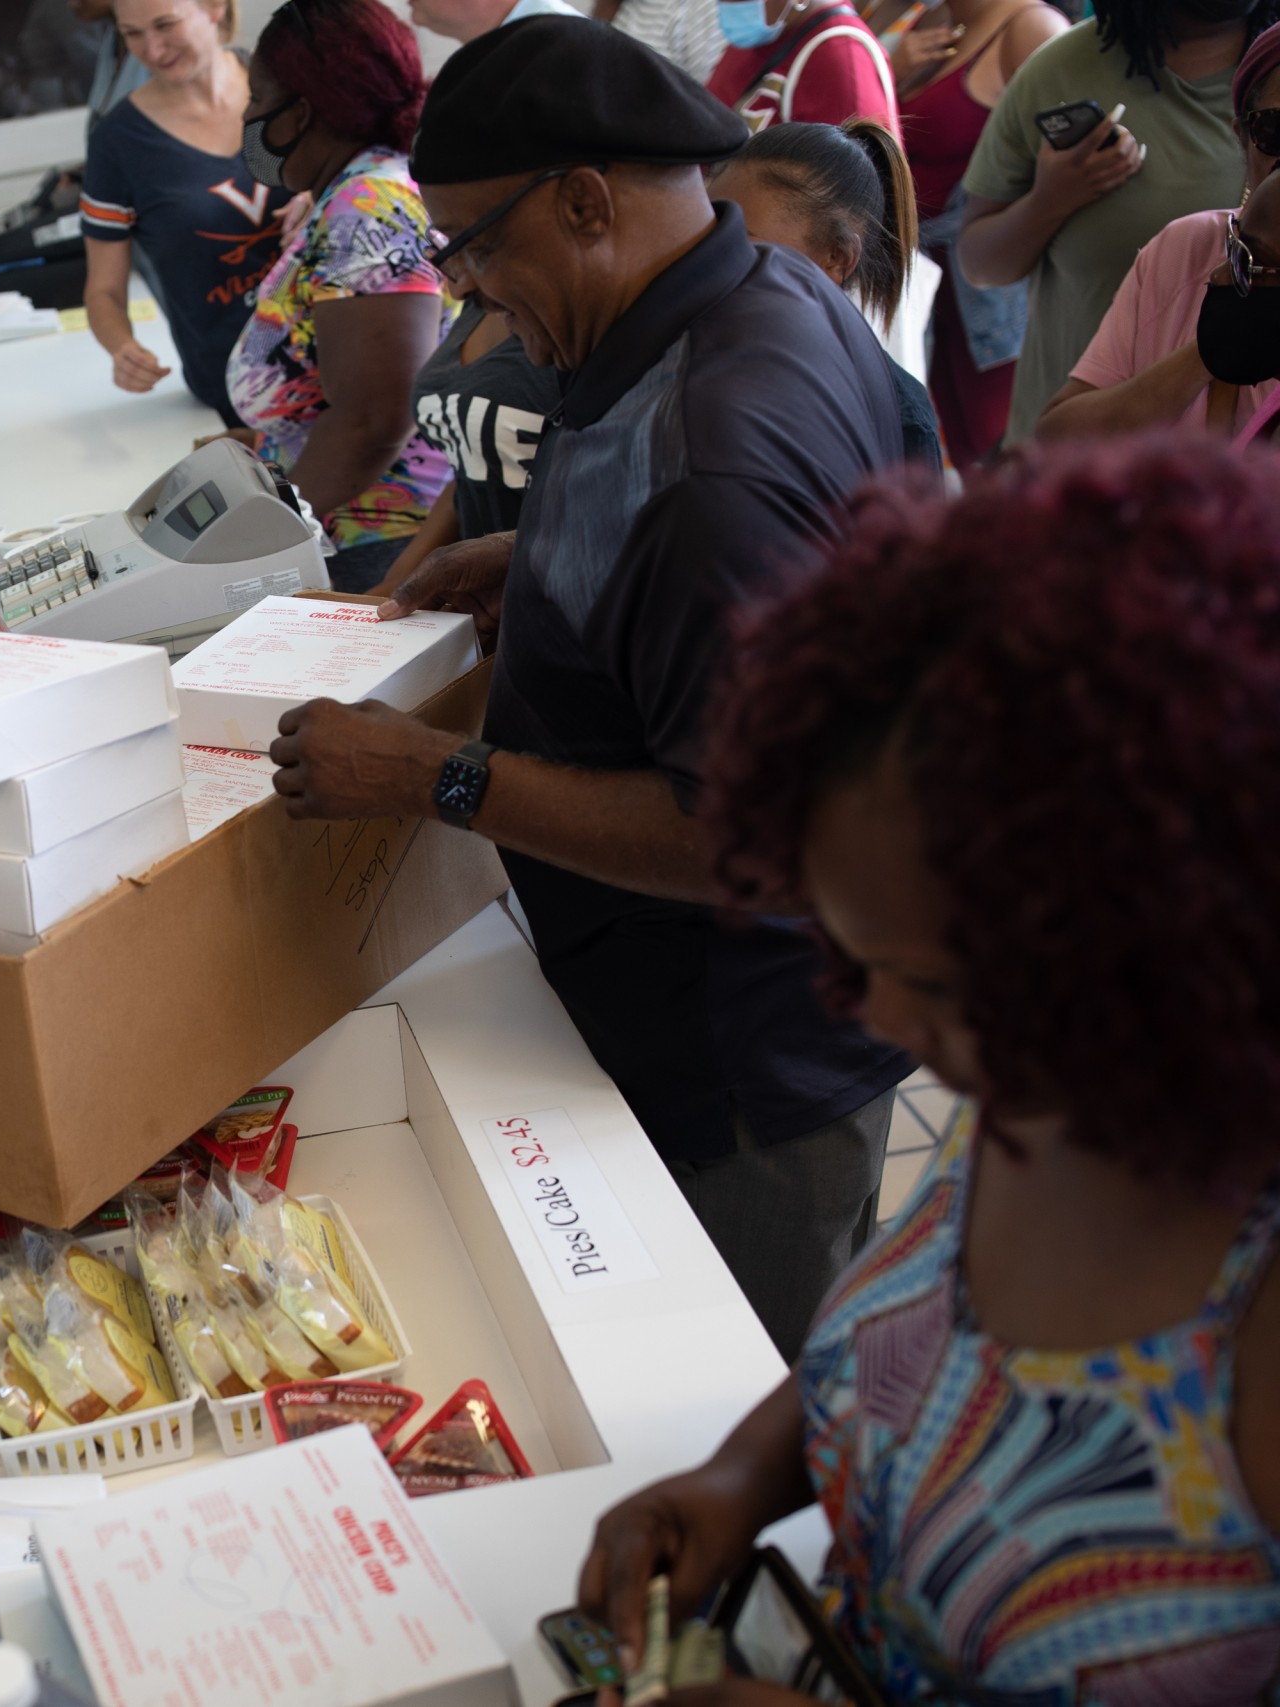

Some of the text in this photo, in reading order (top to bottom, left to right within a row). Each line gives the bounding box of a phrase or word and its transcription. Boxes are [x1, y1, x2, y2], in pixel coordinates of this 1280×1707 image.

[309, 612, 354, 620] CHICKEN
[231, 752, 261, 760] COOP
[496, 1118, 609, 1277] Pies/Cake $2.45
[336, 1391, 380, 1405] PECAN
[383, 1394, 405, 1405] PIE
